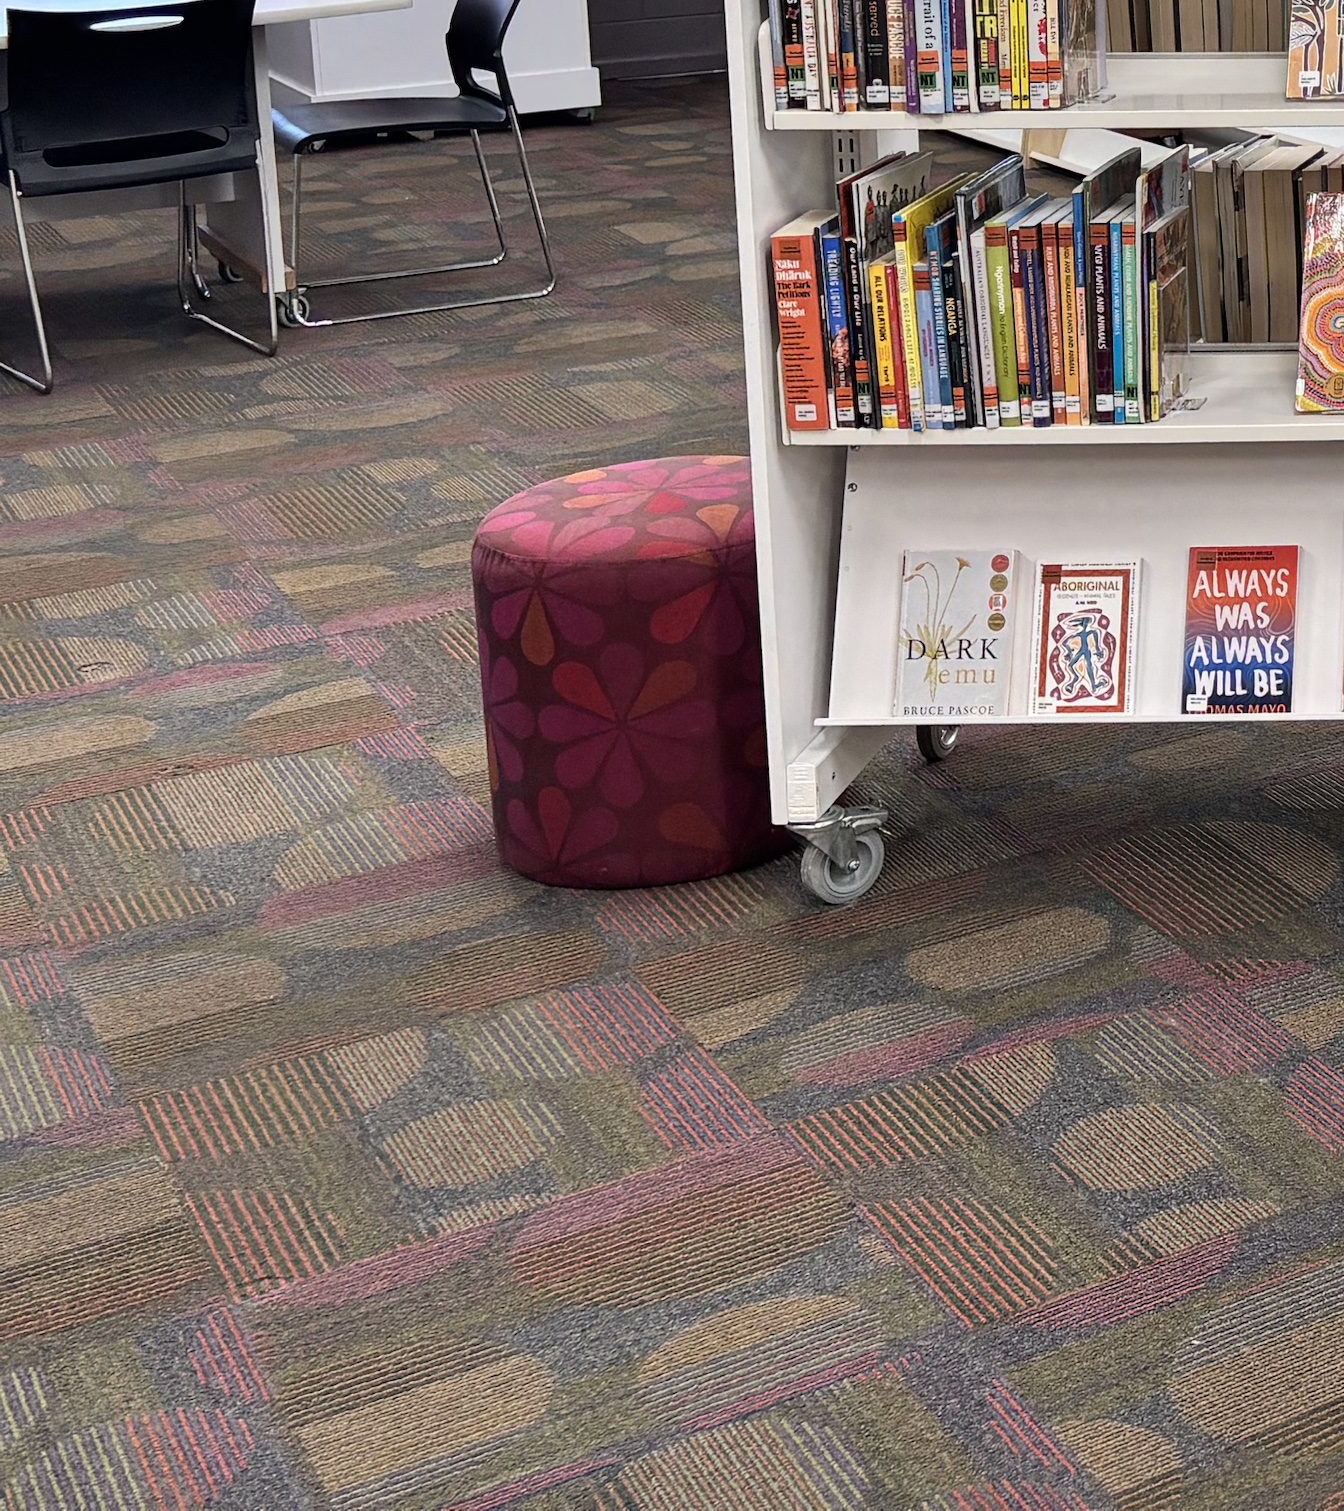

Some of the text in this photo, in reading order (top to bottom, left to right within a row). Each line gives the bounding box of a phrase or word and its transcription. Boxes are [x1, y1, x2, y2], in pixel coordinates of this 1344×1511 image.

[870, 0, 880, 37] served
[1053, 581, 1120, 592] ABORIGINAL
[1193, 568, 1290, 598] ALWAYS
[1214, 602, 1270, 632] WAS
[906, 638, 999, 660] DARK
[1190, 635, 1290, 667] ALWAYS
[938, 667, 996, 684] emu
[1194, 669, 1247, 698] WILL
[903, 705, 995, 716] BRUCE PASCOE
